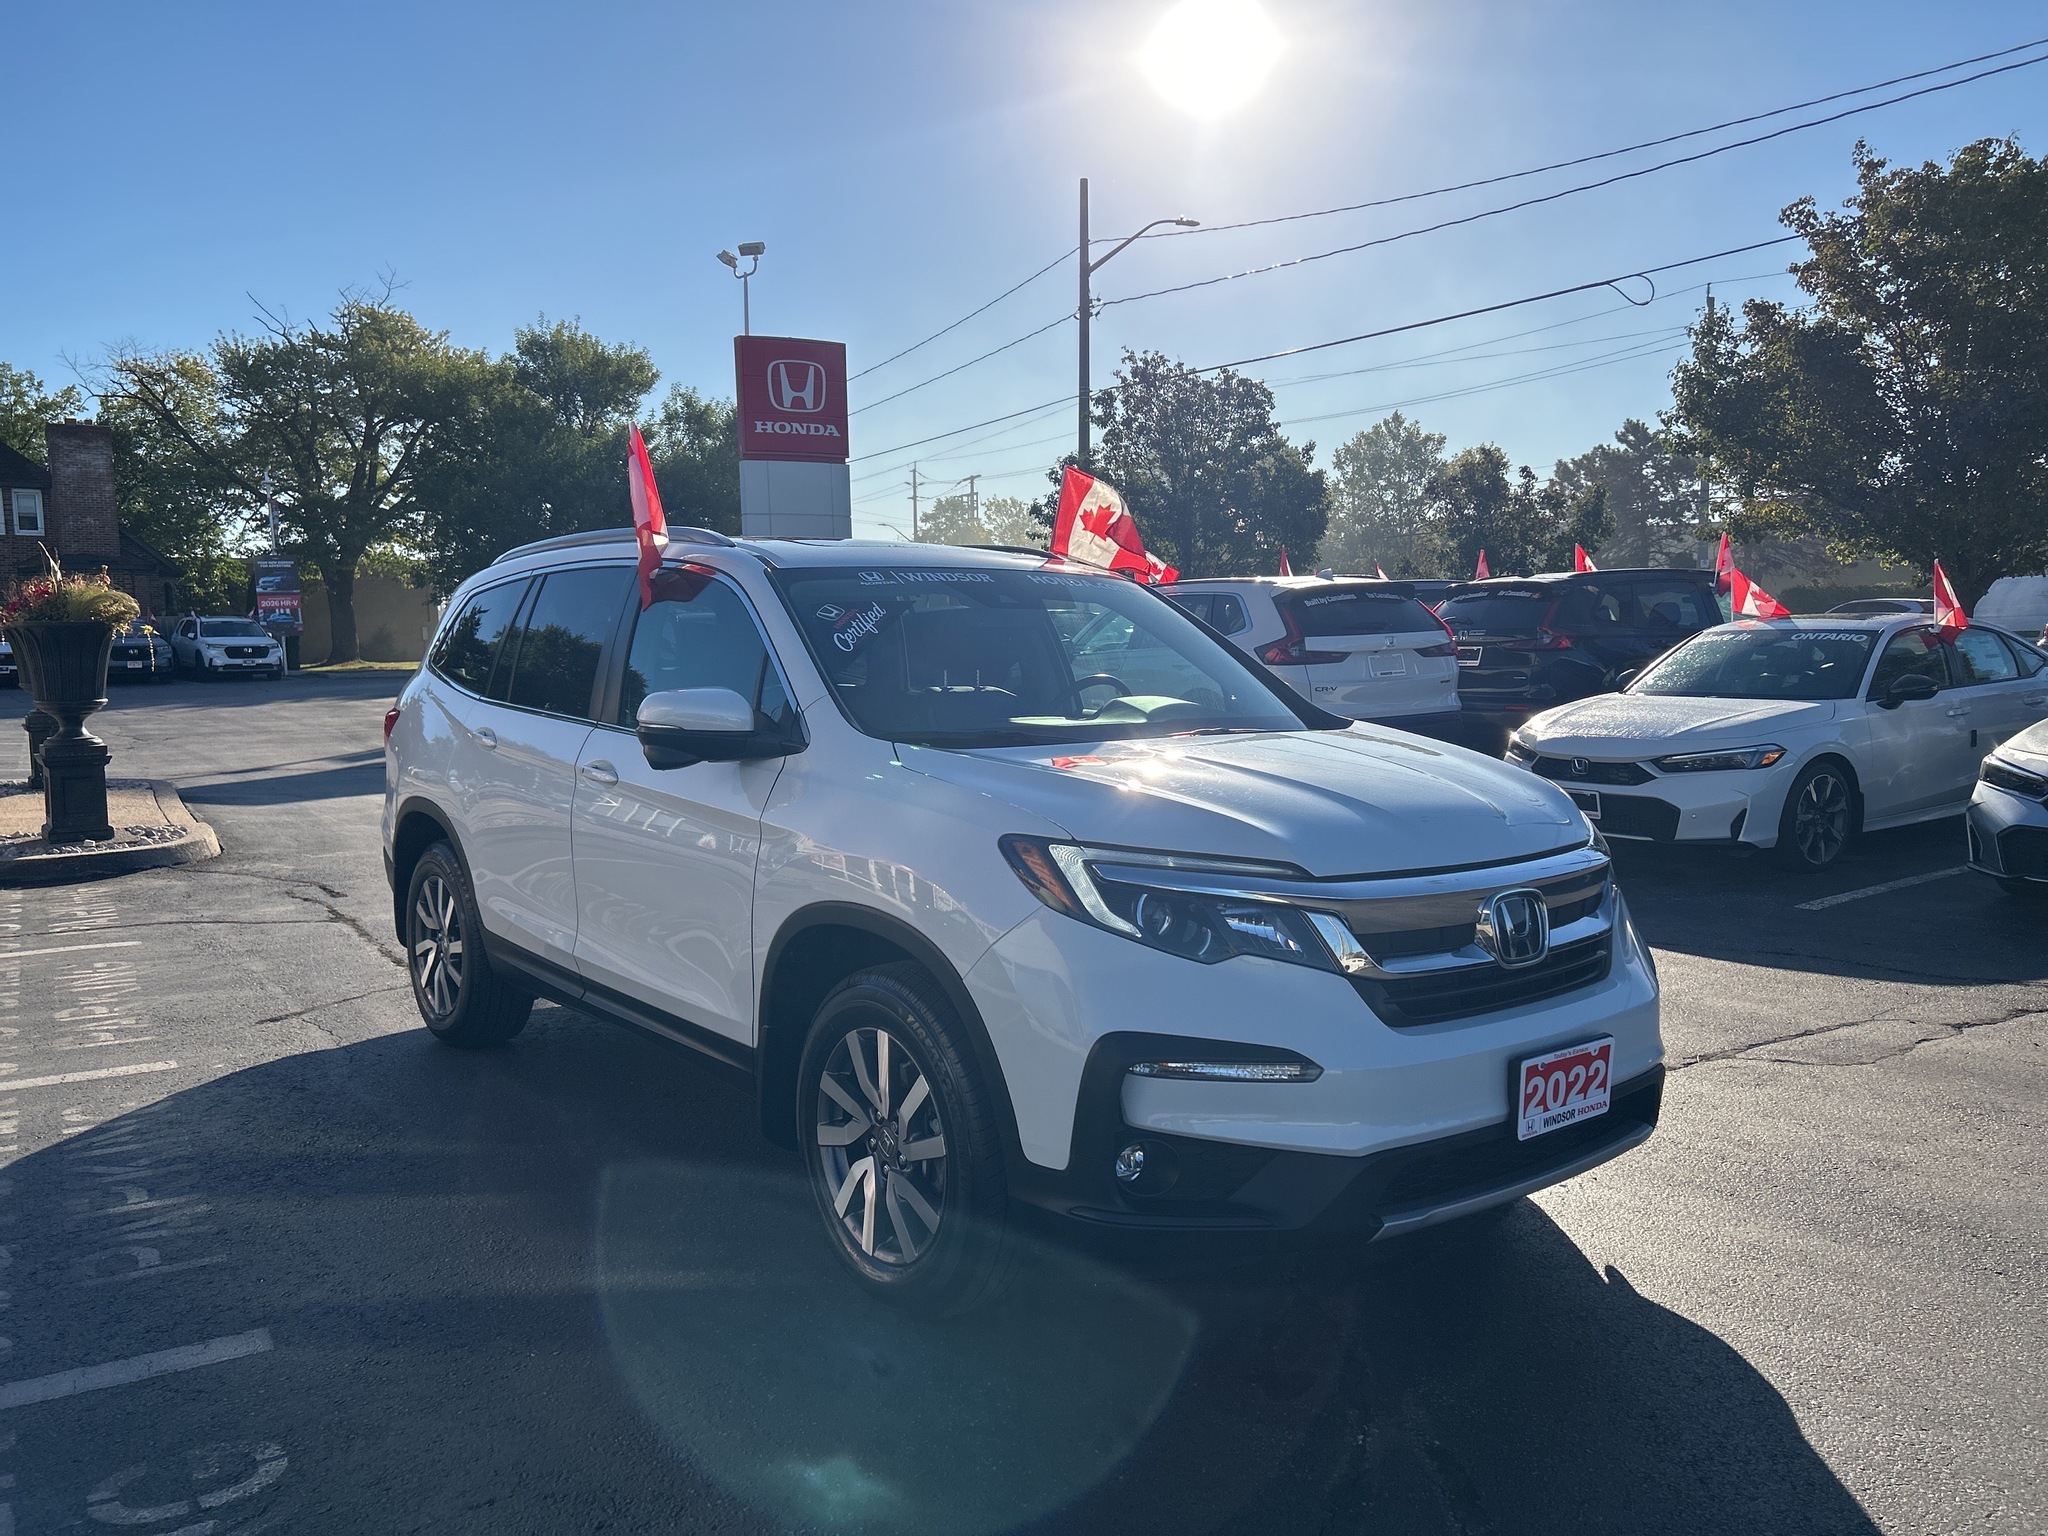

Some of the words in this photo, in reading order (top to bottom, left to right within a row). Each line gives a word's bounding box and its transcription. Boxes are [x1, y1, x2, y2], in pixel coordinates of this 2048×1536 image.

[754, 421, 840, 437] HONDA
[900, 572, 995, 583] WINDSOR
[1304, 597, 1320, 607] Built
[1320, 597, 1328, 605] by
[1326, 593, 1357, 603] Canadians
[833, 601, 886, 652] Certified
[1791, 632, 1868, 642] ONTARIO
[1524, 1059, 1606, 1119] 2022
[1543, 1108, 1576, 1129] WINDSOR
[1577, 1101, 1608, 1117] HONDA
